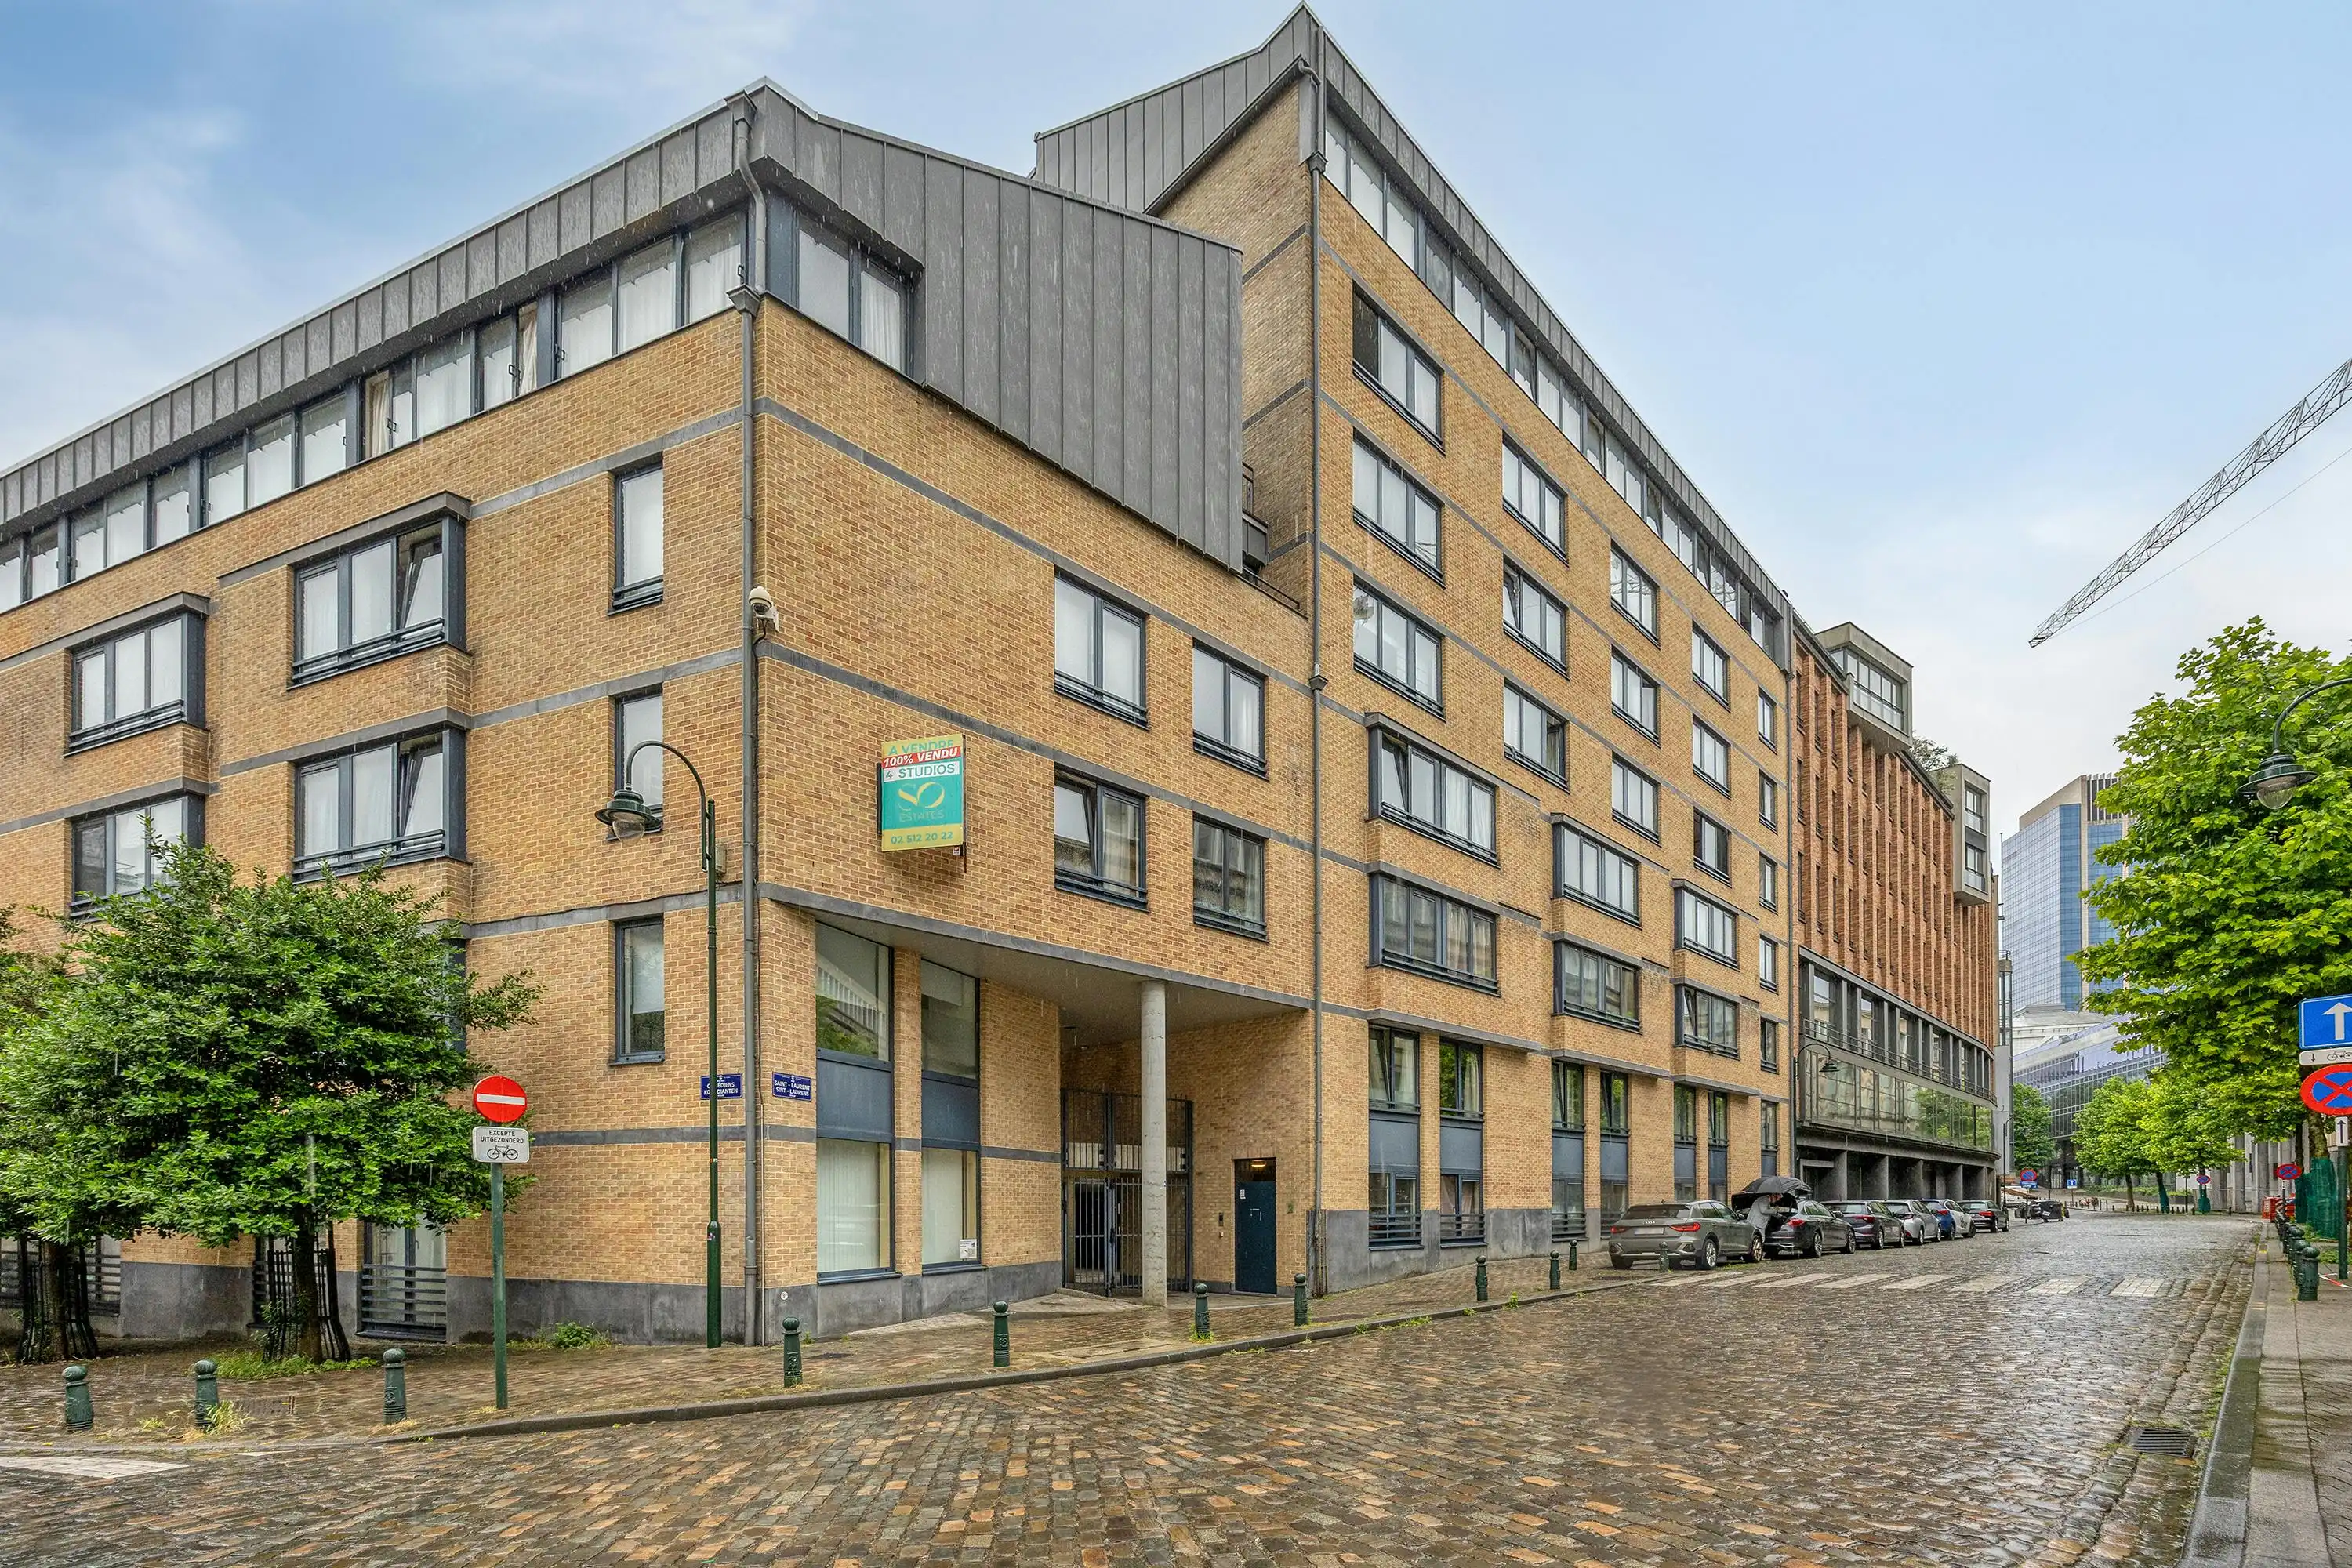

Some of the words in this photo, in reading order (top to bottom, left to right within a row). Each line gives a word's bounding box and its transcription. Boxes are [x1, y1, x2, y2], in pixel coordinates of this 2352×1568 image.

[901, 739, 954, 754] VENDRE
[884, 754, 913, 768] 100%
[917, 747, 958, 762] VENDU
[885, 770, 893, 779] 4
[898, 763, 955, 779] STUDIOS
[899, 810, 945, 822] ESTATES
[891, 836, 903, 844] 02
[906, 833, 922, 843] 512
[925, 832, 938, 841] 20
[941, 831, 953, 840] 22
